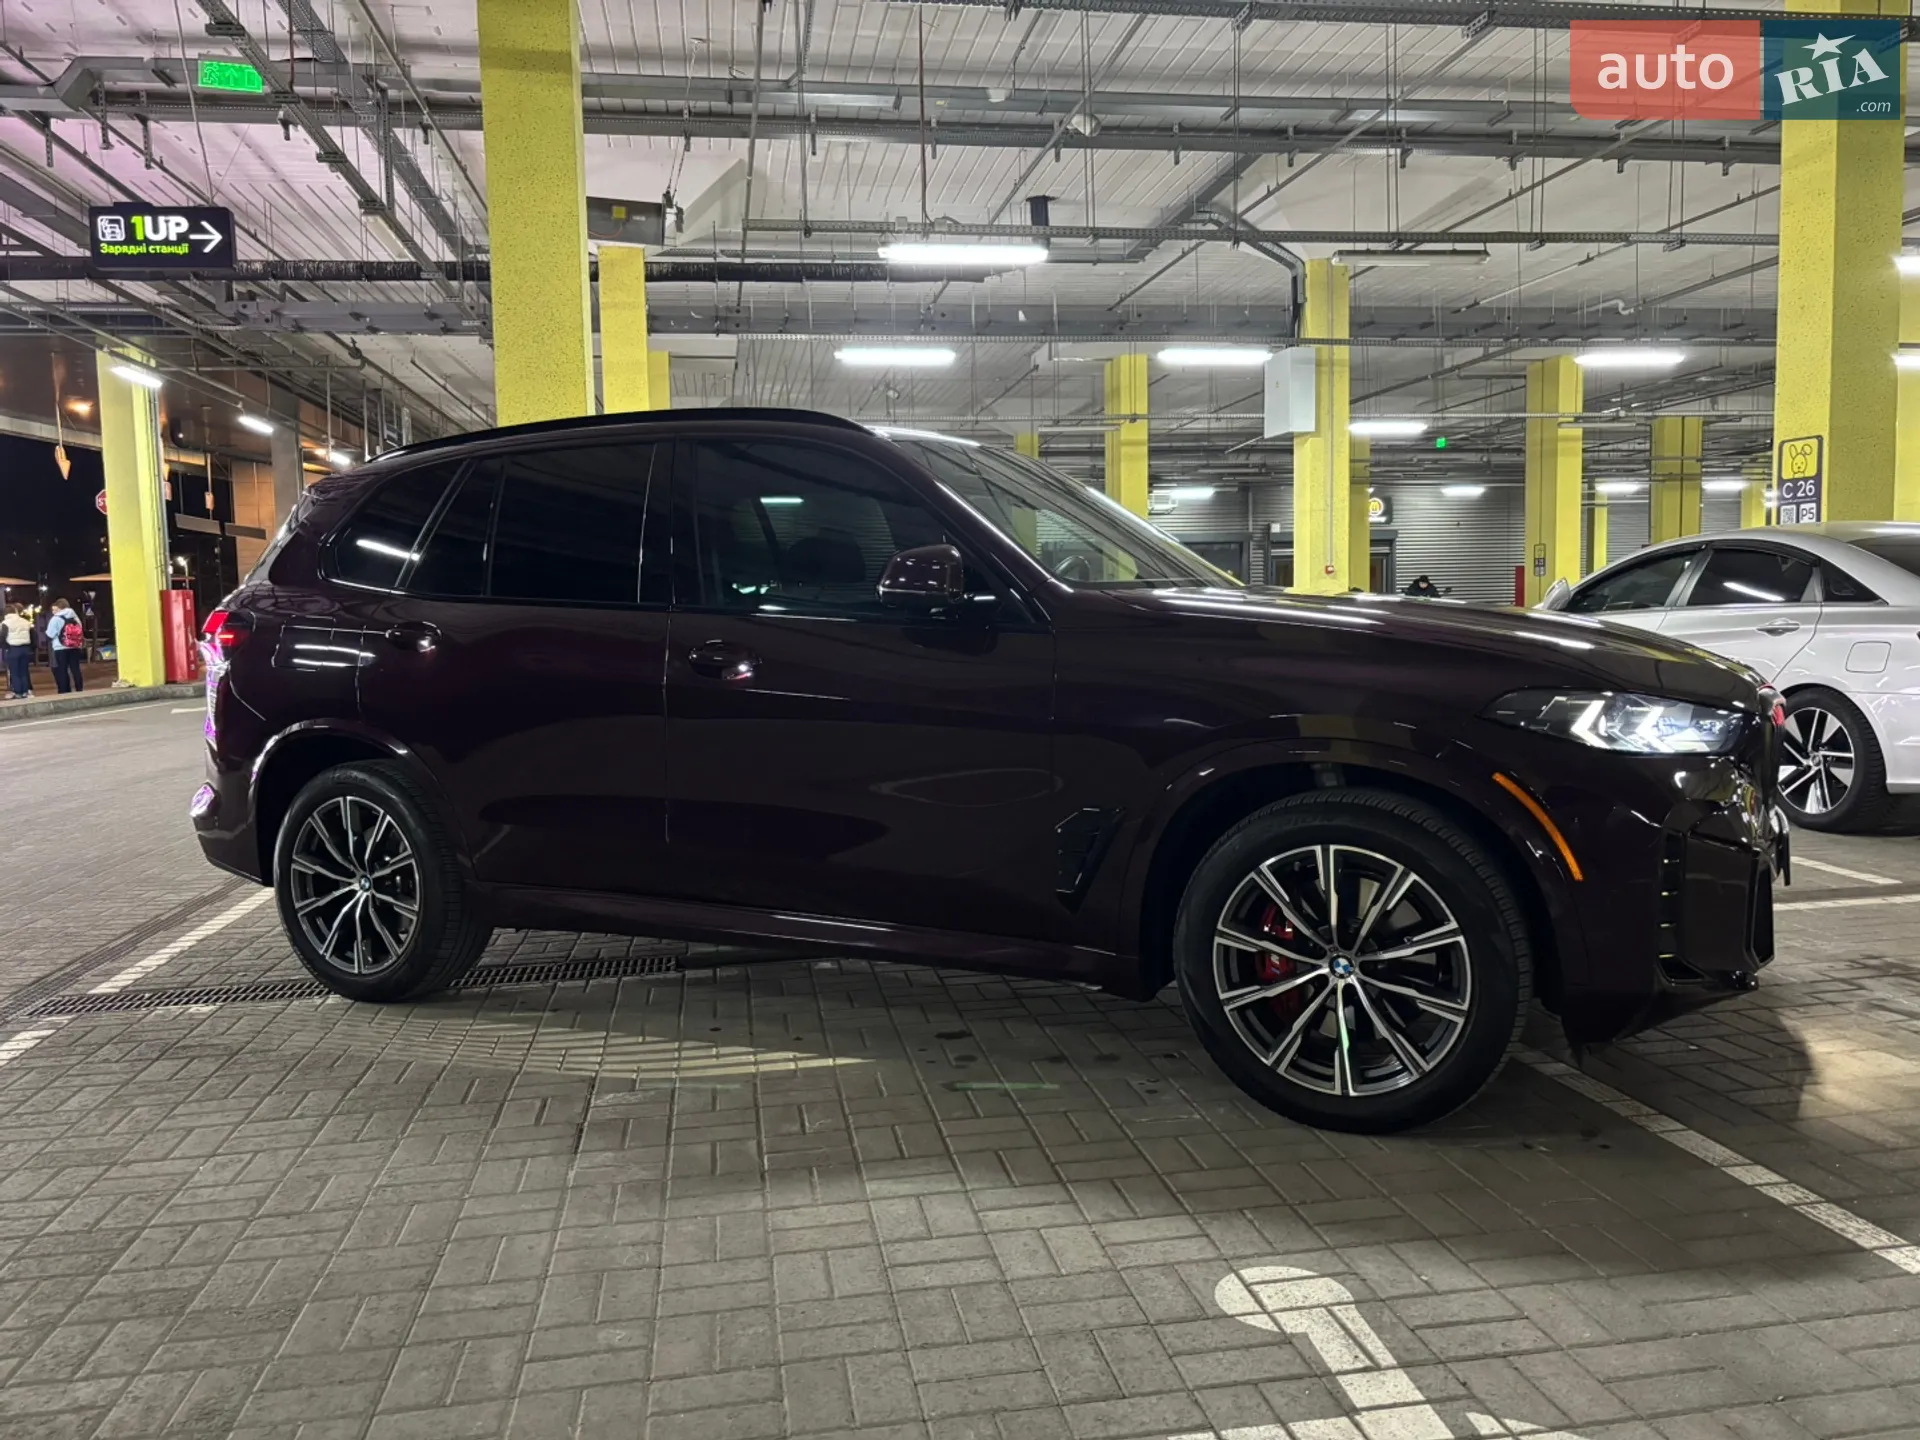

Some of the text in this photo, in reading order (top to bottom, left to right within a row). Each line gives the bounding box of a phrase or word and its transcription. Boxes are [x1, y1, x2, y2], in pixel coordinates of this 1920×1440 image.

[131, 215, 190, 241] 1UP
[100, 243, 189, 256] Зарядні станції
[1782, 480, 1816, 498] C 26
